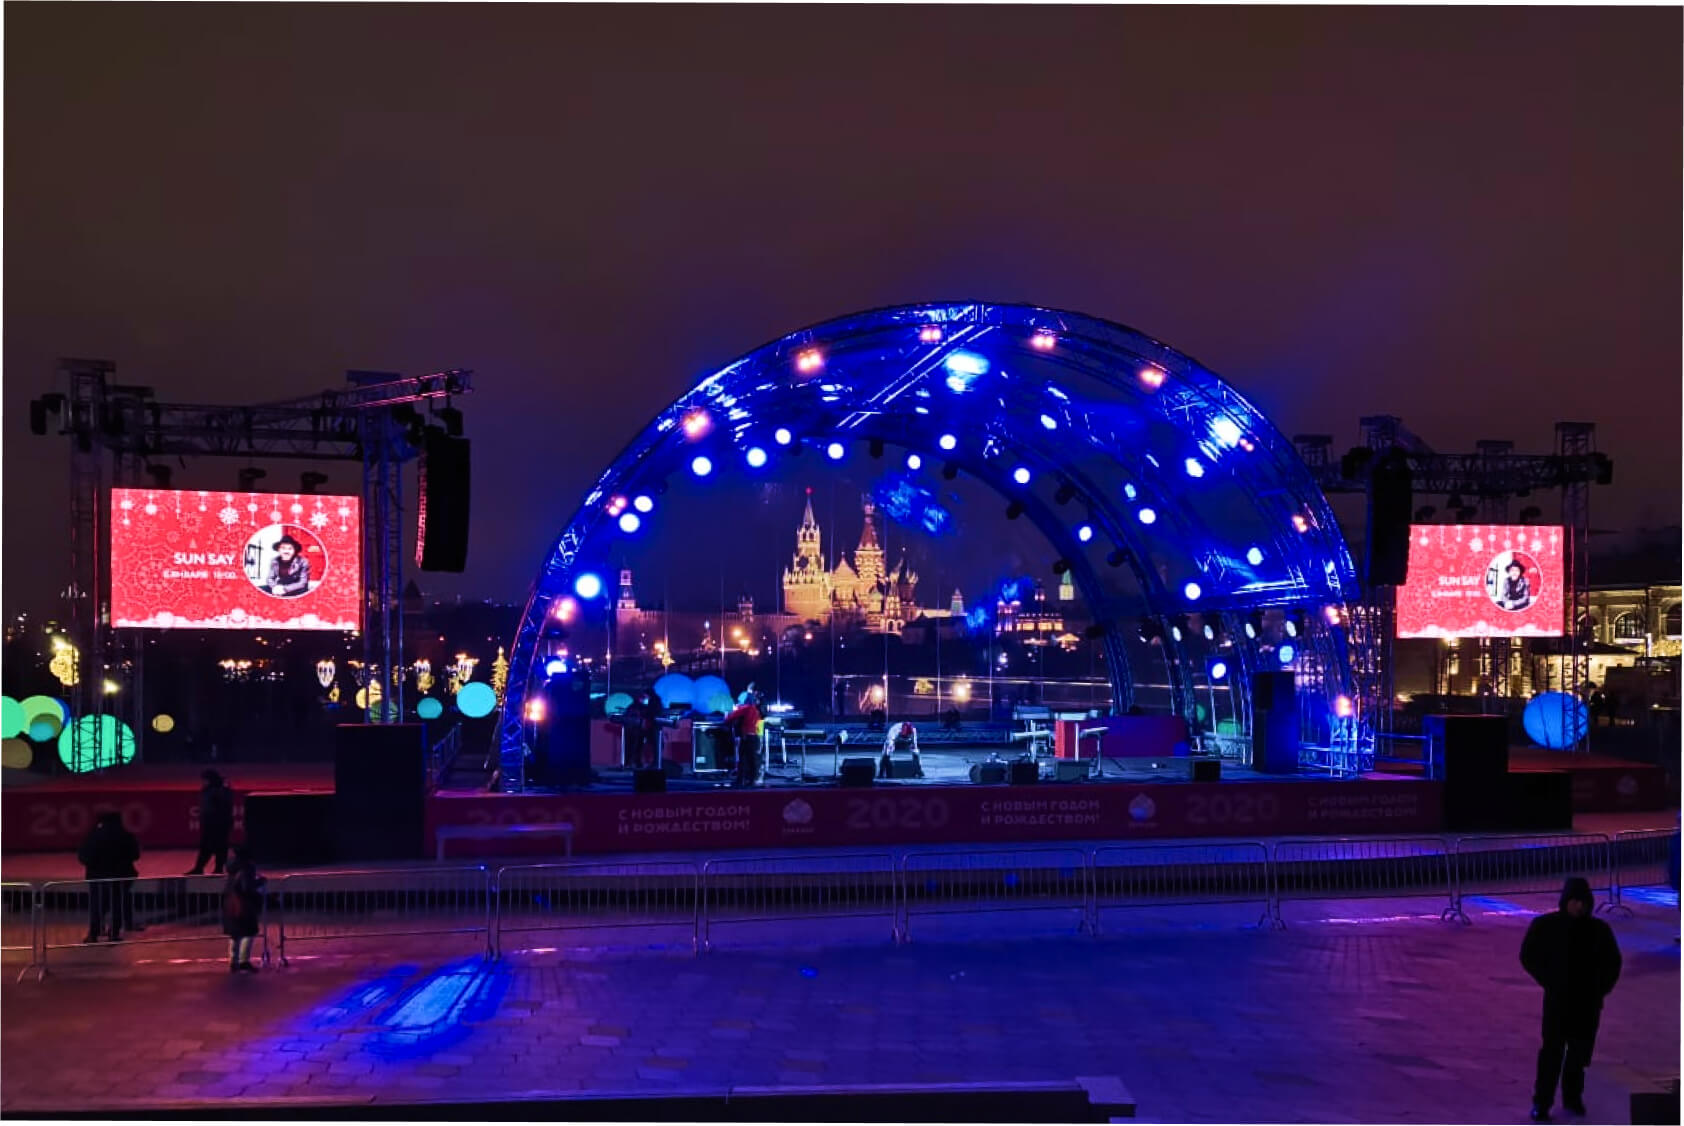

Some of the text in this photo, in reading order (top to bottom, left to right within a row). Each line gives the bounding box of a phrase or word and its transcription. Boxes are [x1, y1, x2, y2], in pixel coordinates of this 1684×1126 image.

[174, 551, 236, 565] SUN SAY
[1438, 576, 1460, 586] SUN
[631, 807, 692, 819] НОВЫМ
[696, 805, 750, 818] ГОДОМ
[993, 800, 1047, 811] НОВЫМ
[1050, 799, 1100, 811] ГОДОМ
[1185, 792, 1281, 824] 2020
[28, 802, 152, 835] 200
[846, 796, 951, 829] 2020
[995, 814, 1100, 825] РОЖДЕСТВОМ!
[633, 820, 751, 833] РОЖДЕСТВОМ!
